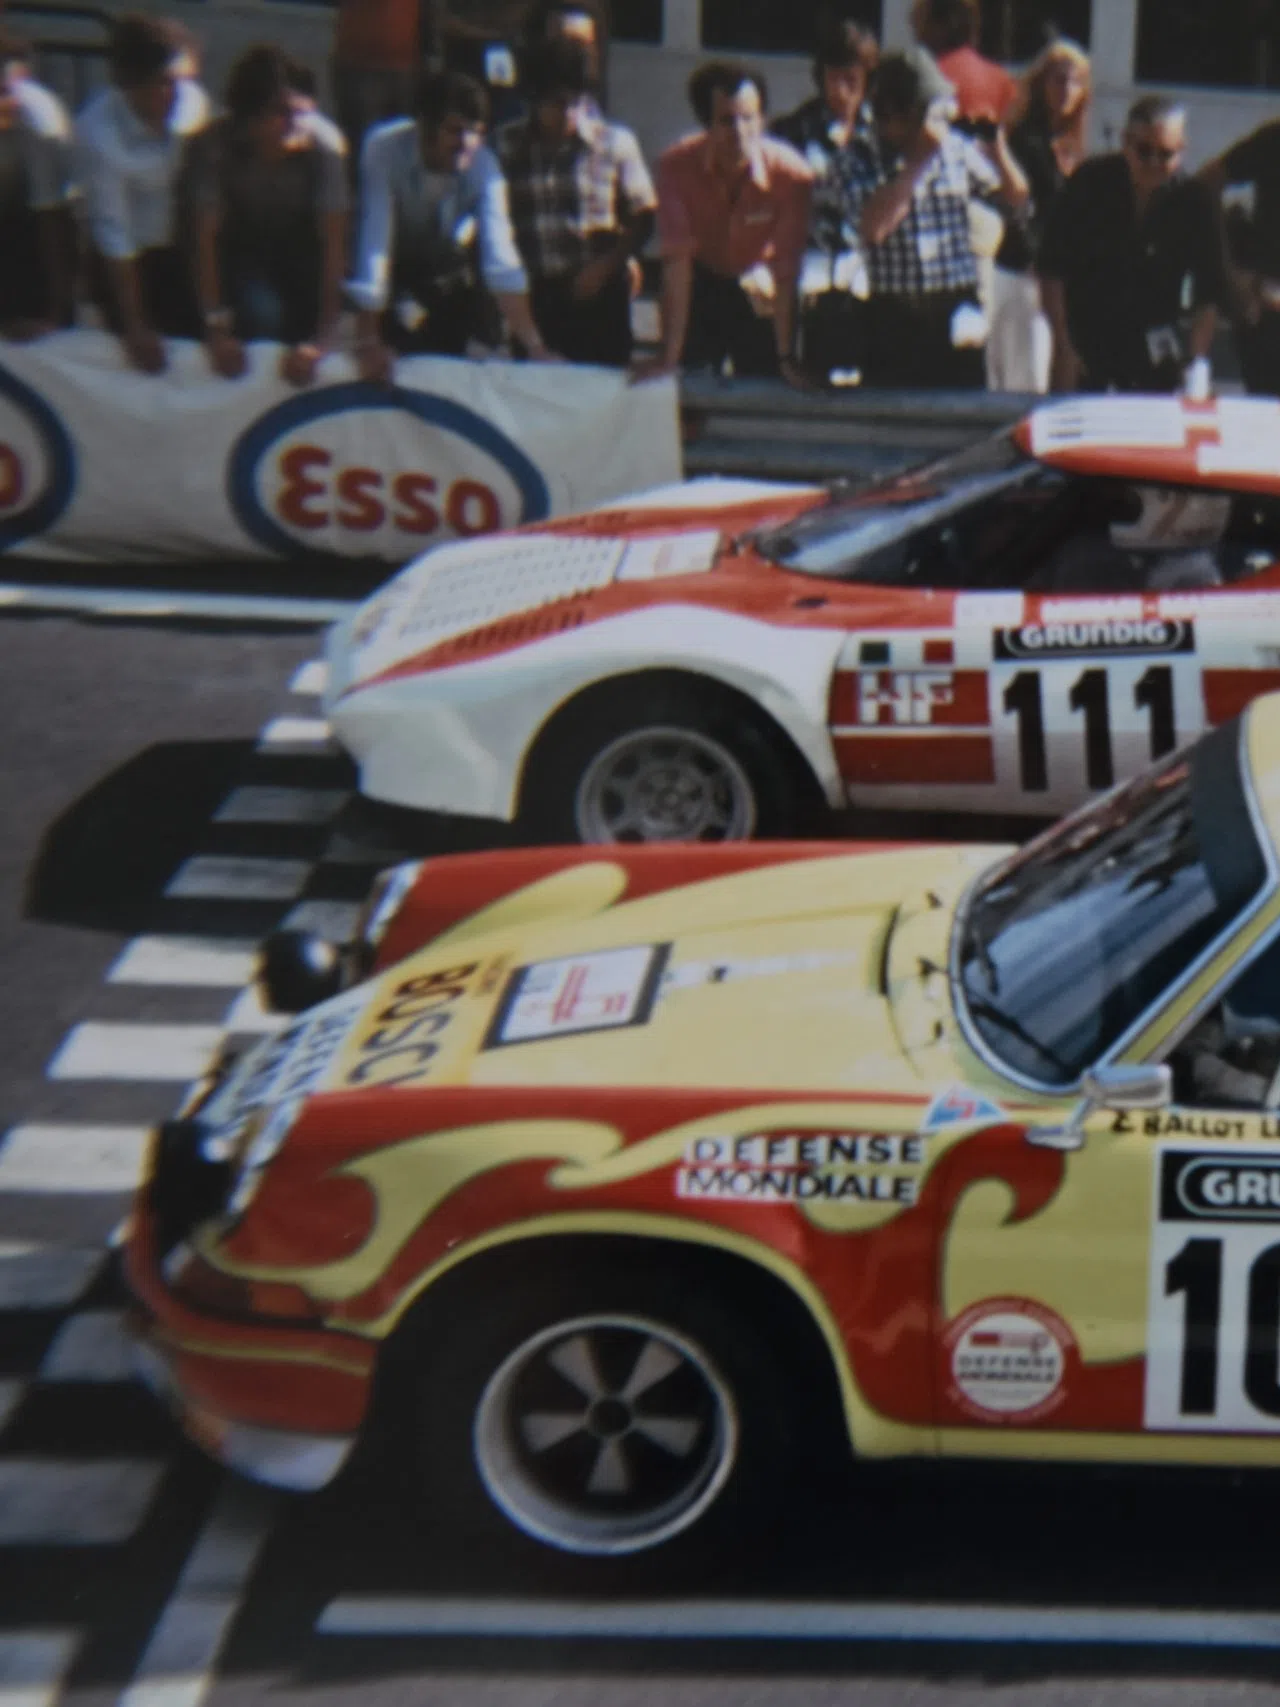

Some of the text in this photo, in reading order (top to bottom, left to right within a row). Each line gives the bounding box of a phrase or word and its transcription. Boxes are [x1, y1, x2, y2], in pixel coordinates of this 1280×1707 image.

[859, 671, 954, 726] HF
[1003, 665, 1177, 793] 111
[1143, 1114, 1246, 1139] BALLOT
[694, 1137, 922, 1165] DEFENSE
[683, 1168, 916, 1202] MONDIALE
